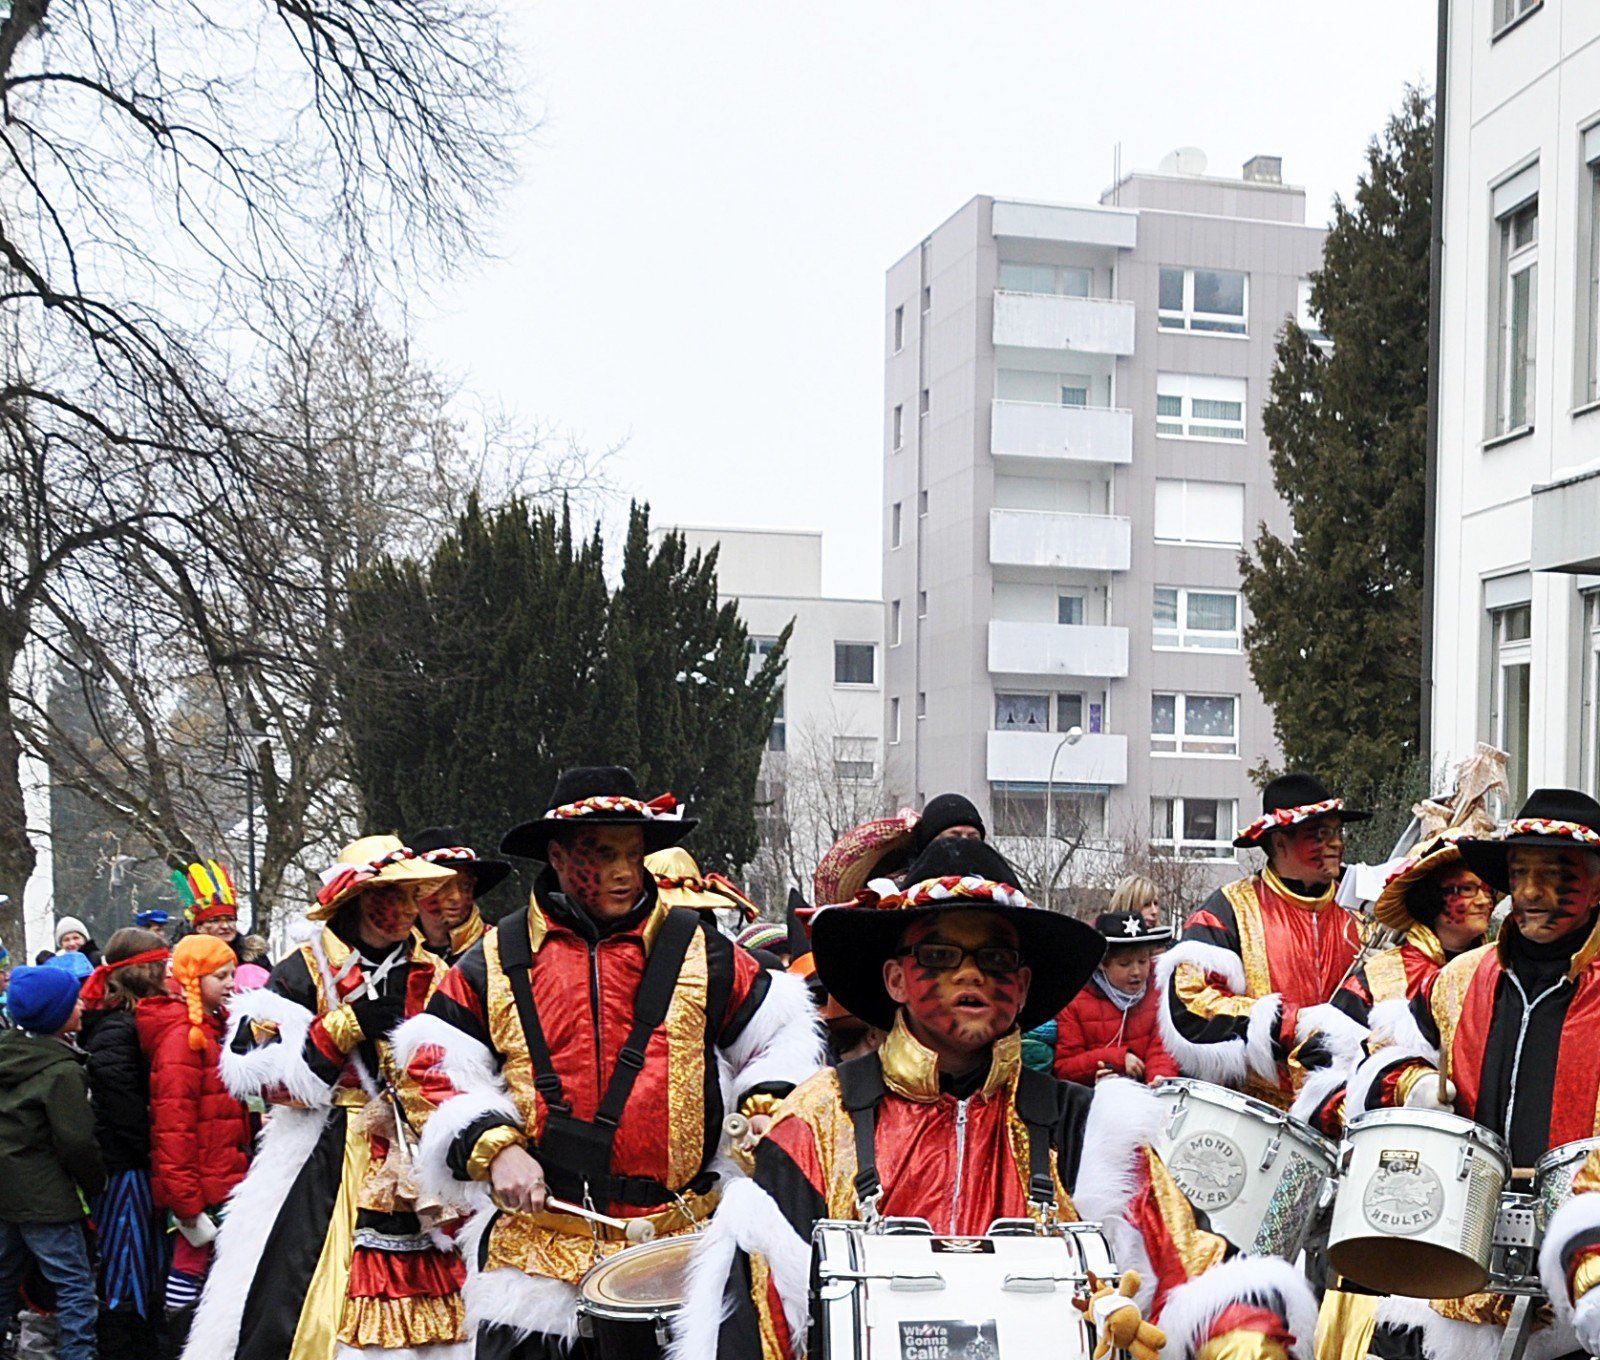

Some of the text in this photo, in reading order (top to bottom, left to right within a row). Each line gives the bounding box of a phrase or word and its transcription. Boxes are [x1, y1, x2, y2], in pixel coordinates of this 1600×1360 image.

[1190, 1138, 1233, 1157] MOND
[1371, 1208, 1433, 1225] HEULER
[932, 1325, 948, 1336] Ya
[905, 1335, 949, 1347] Gonna
[905, 1345, 950, 1360] Call?
